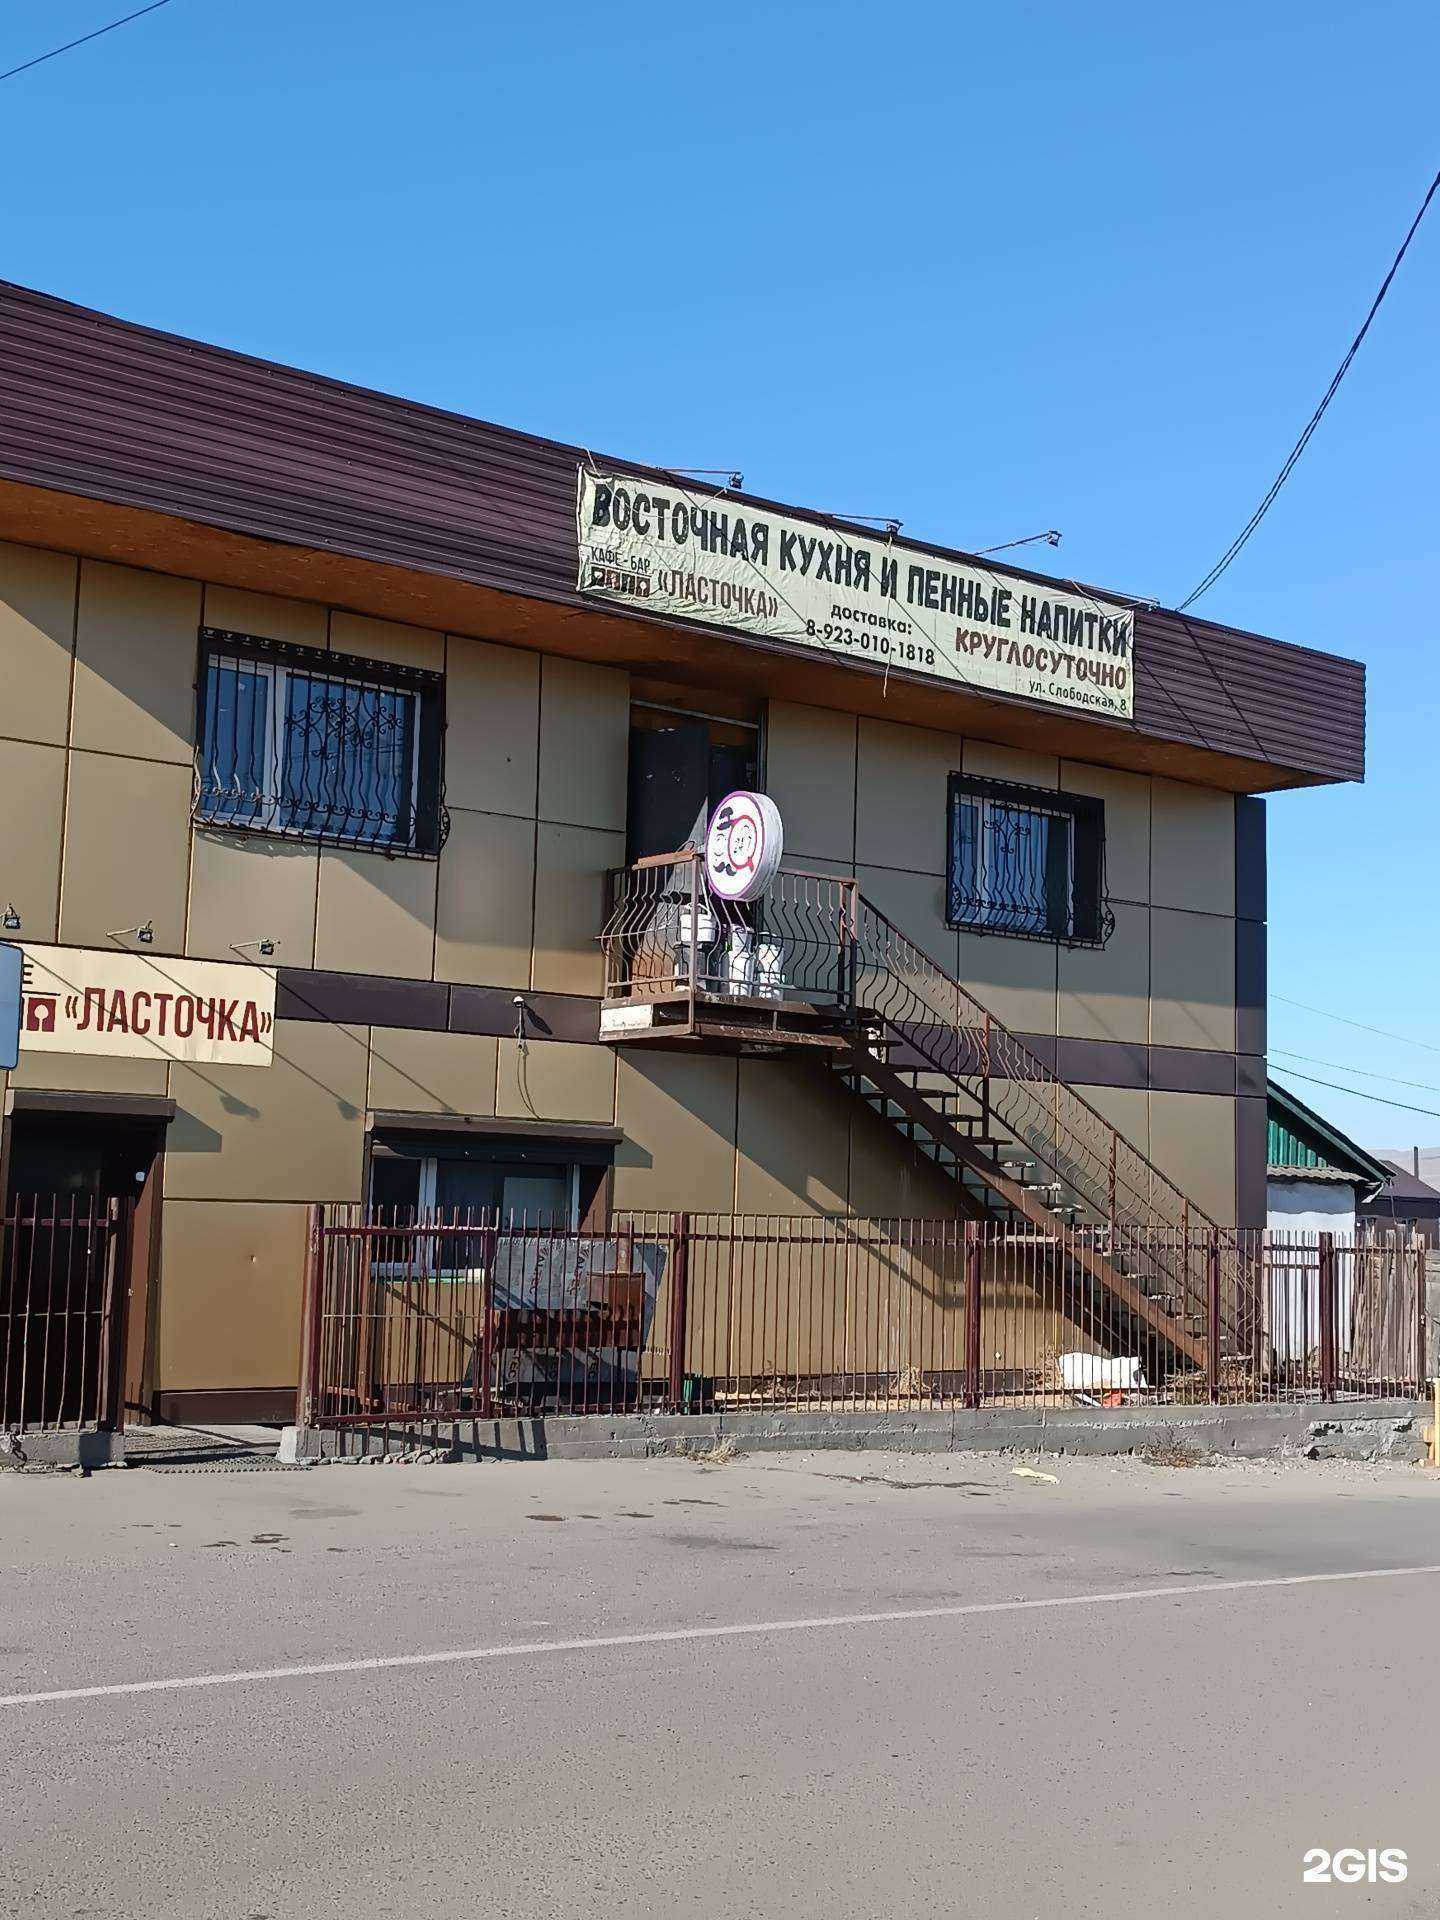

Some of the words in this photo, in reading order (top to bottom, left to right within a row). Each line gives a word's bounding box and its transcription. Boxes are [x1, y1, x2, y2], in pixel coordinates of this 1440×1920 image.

[592, 482, 769, 566] ВОСТОЧНАЯ
[779, 528, 871, 593] КУХНЯ
[880, 556, 898, 599] И
[906, 564, 1012, 628] ПЕННЫЕ
[1020, 594, 1127, 657] НАПИТКИ
[657, 569, 778, 619] «ЛАСТОЧКА»
[806, 619, 935, 665] 8-923-010-1818
[831, 604, 912, 635] доставка:
[955, 626, 1126, 690] КРУГЛОСУТОЧНО
[1029, 681, 1046, 693] ул.
[1048, 682, 1118, 711] Слободская,
[1120, 699, 1127, 711] 8
[65, 986, 272, 1042] «ЛАСТОЧКА»
